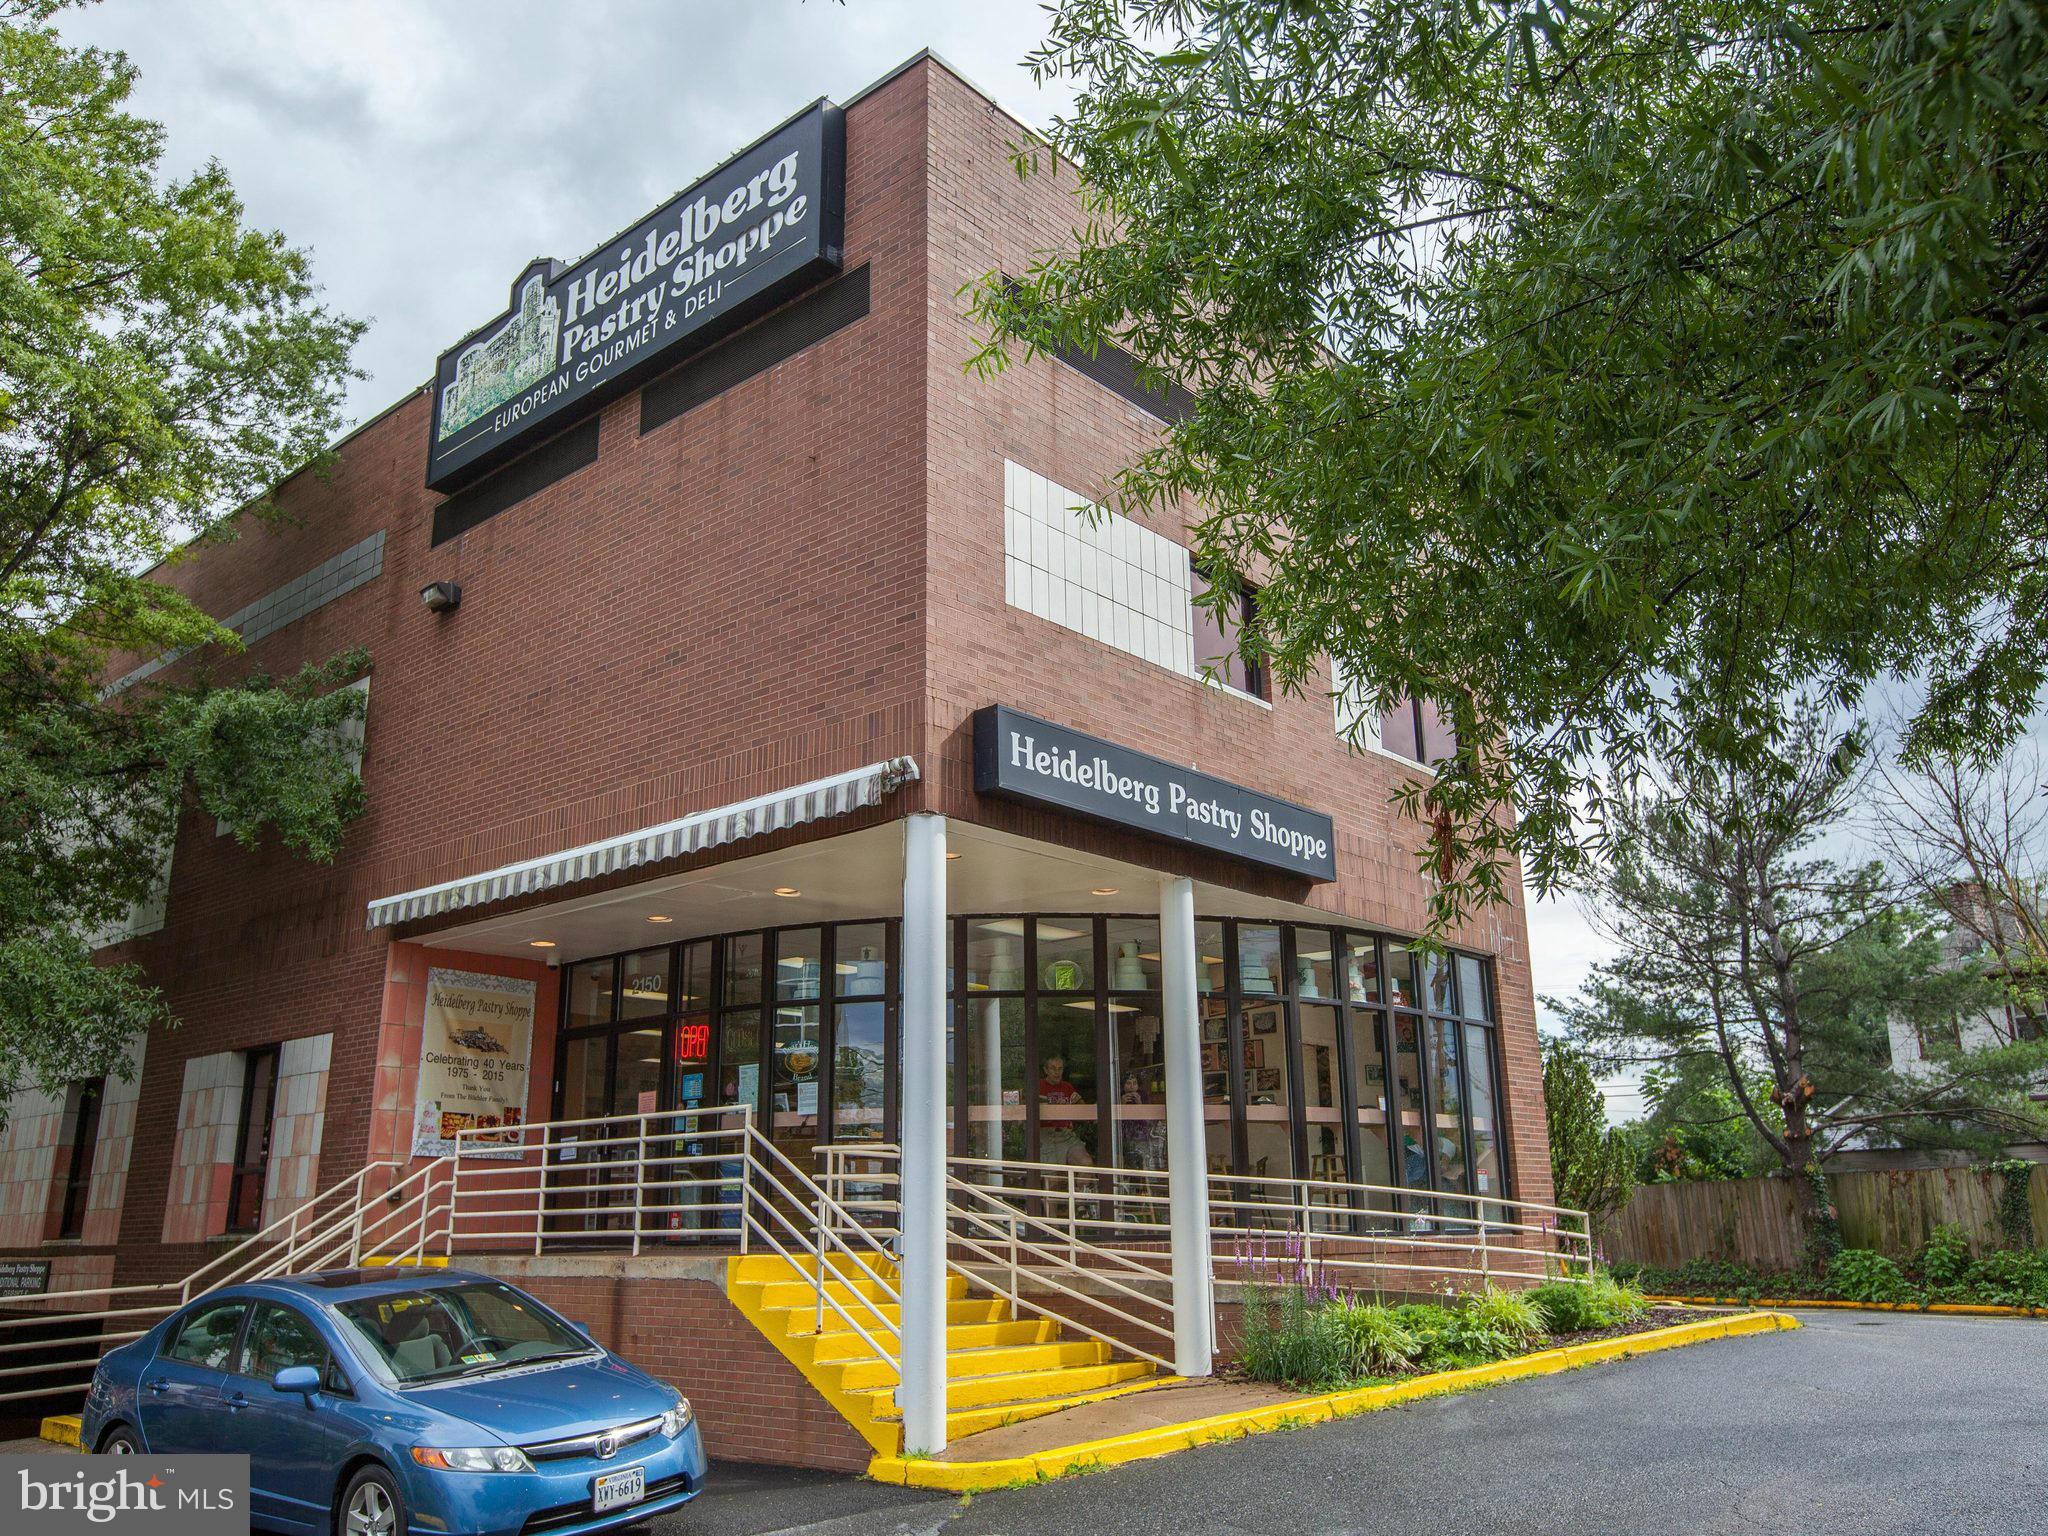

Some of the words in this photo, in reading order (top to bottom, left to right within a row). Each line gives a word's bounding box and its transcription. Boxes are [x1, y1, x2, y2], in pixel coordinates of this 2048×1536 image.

[564, 150, 799, 327] Heidelberg
[561, 280, 666, 366] Pastry
[671, 194, 807, 299] Shoppe
[494, 372, 571, 433] EUROPEAN
[575, 319, 659, 384] GOURMET
[665, 310, 676, 331] &
[685, 280, 721, 319] DELI
[1010, 731, 1160, 815] Heidelberg
[1168, 782, 1242, 839] Pastry
[1250, 808, 1327, 861] Shoppe
[632, 974, 662, 995] 2150
[431, 991, 476, 1016] Heidelberg
[477, 999, 504, 1019] Pastry
[505, 1001, 531, 1021] Shoppe
[425, 1052, 479, 1069] Celebrating
[483, 1058, 495, 1069] 40
[500, 1060, 525, 1072] Years
[447, 1067, 469, 1079] 1975
[482, 1070, 504, 1081] 2015
[462, 1084, 477, 1092] Thank
